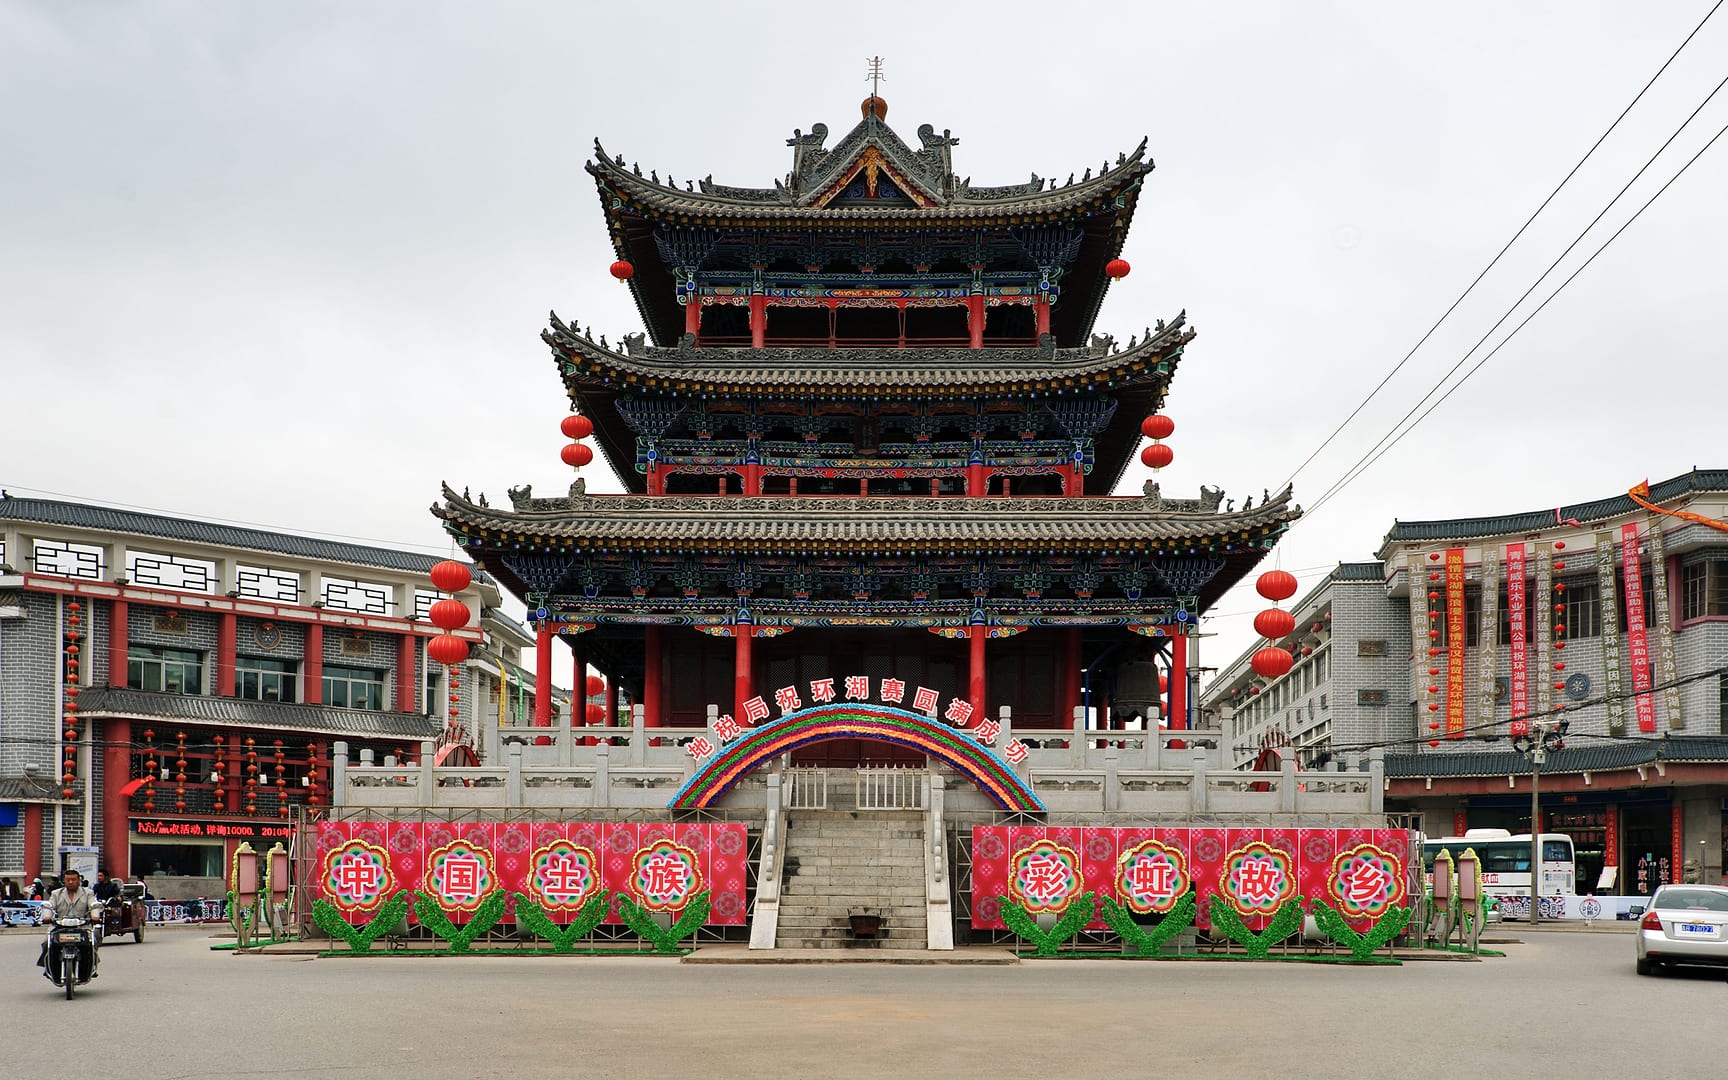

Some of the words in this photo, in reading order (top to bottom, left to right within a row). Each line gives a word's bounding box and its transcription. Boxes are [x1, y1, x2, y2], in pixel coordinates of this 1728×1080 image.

[688, 676, 1030, 765] 地税局祝环湖赛圆满成功
[340, 857, 686, 898] 中国土族
[1026, 859, 1385, 902] 彩虹故乡
[1659, 857, 1670, 884] 化妆
